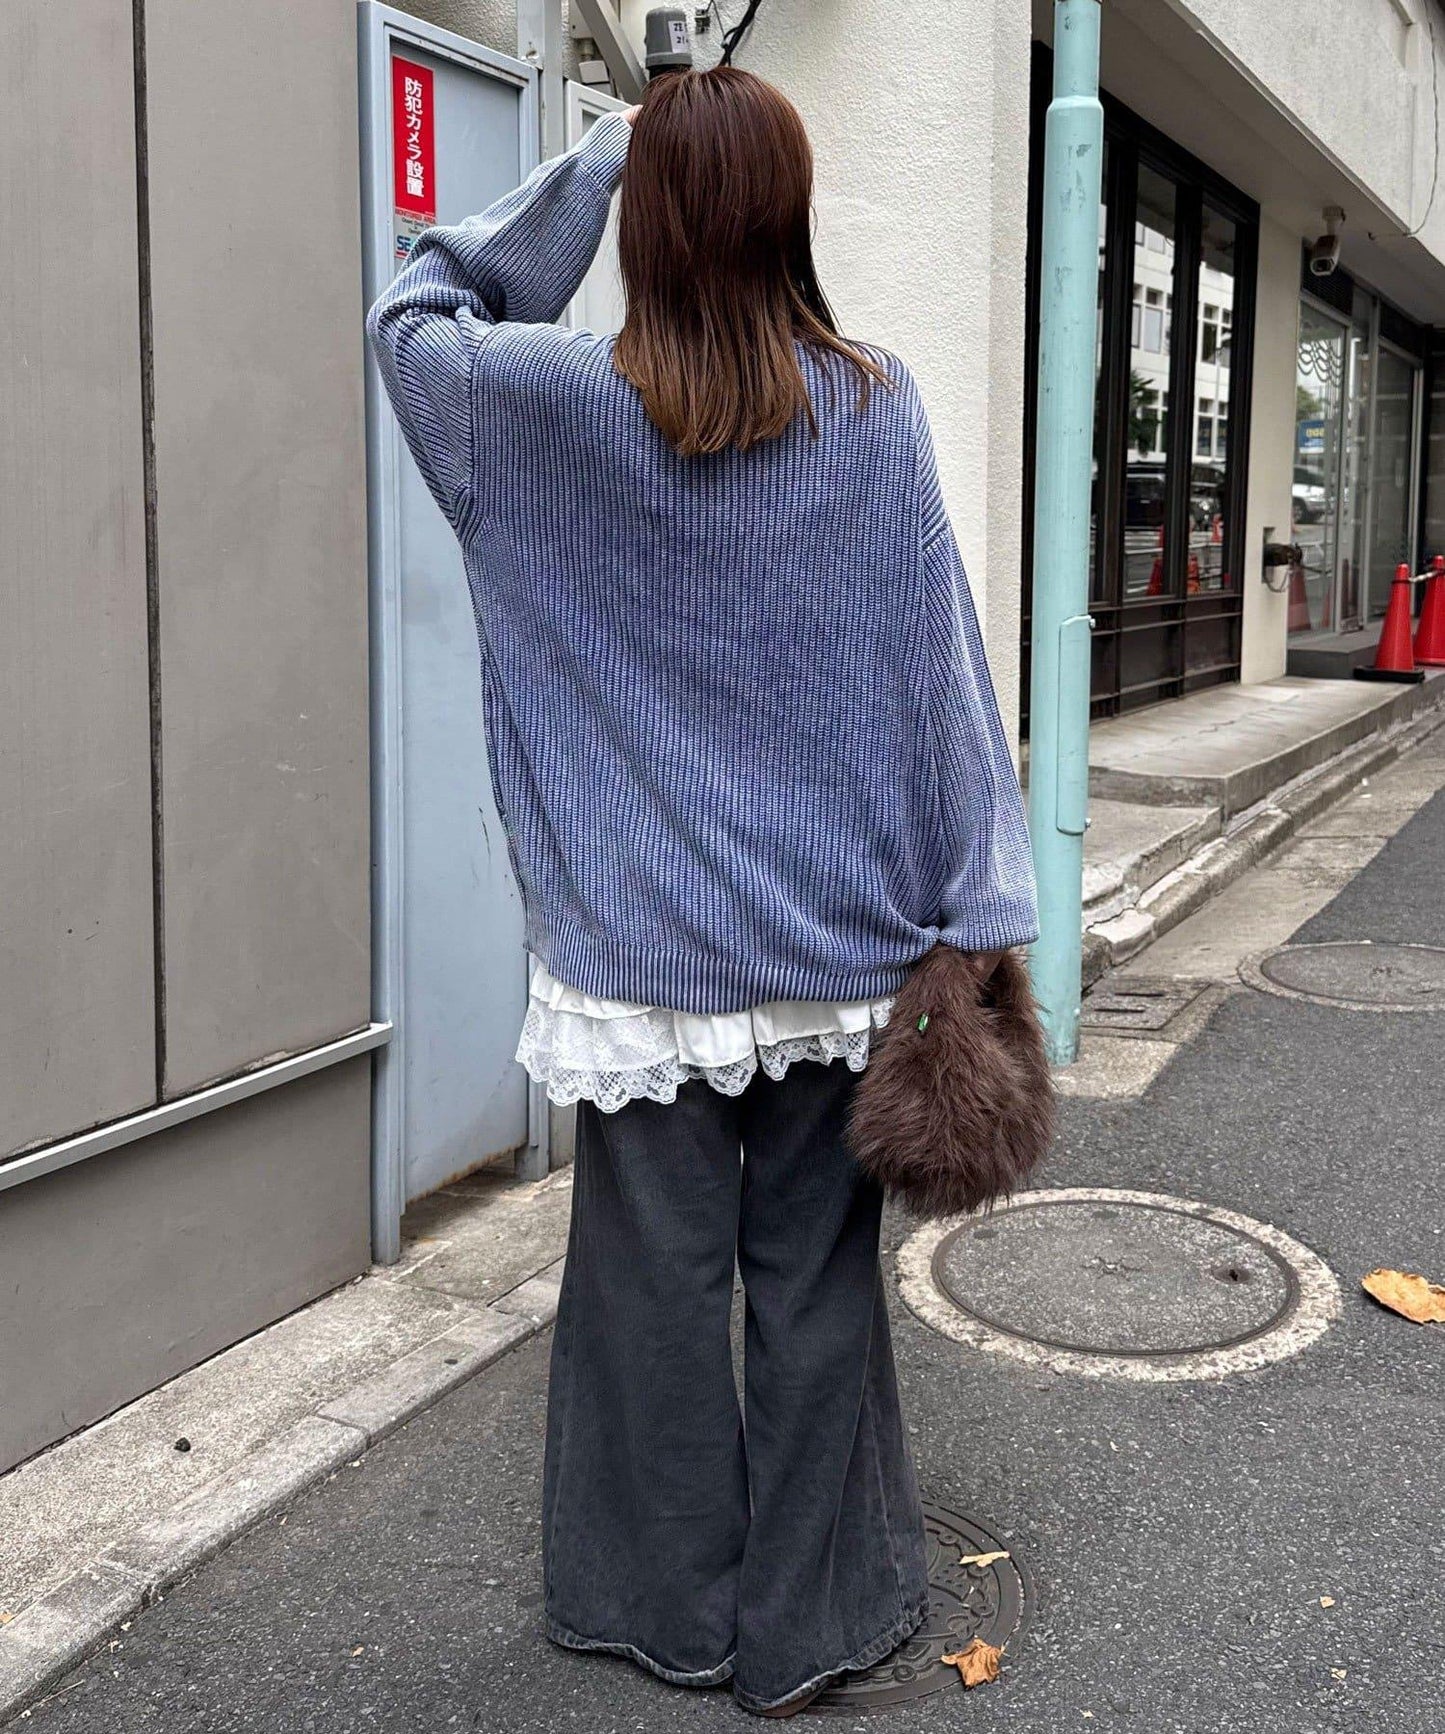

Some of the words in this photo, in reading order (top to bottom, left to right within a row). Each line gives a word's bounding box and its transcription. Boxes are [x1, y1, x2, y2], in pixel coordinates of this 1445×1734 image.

[404, 76, 424, 198] 防犯カメラ設置
